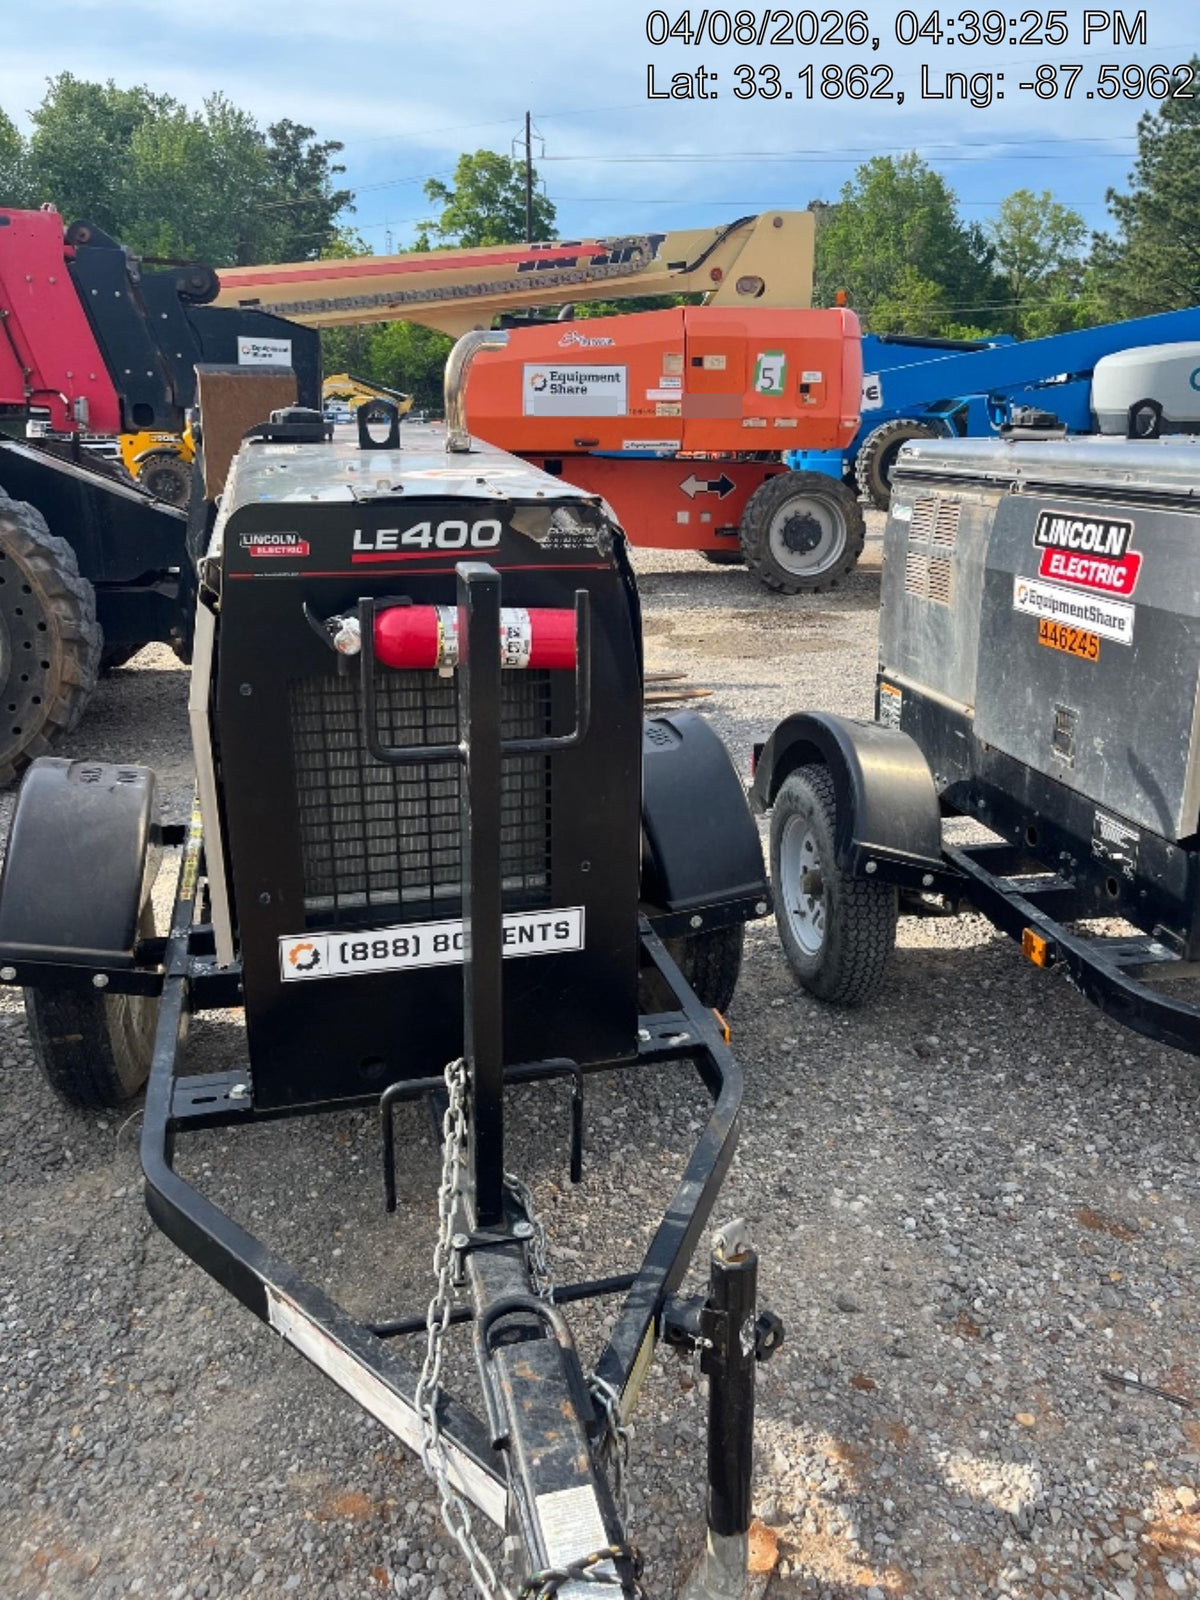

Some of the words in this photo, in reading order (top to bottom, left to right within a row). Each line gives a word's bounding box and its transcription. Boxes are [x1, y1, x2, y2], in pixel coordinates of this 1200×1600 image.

[550, 371, 621, 386] Equipment
[550, 384, 588, 395] Share
[761, 367, 774, 391] 5
[242, 533, 297, 545] LINCOLN
[353, 519, 502, 550] LE400
[1038, 516, 1127, 556] LINCOLN
[256, 546, 304, 554] ELECTRIC
[1049, 553, 1127, 588] ELECTRIC
[1028, 589, 1126, 631] EquipmentShare
[1039, 621, 1099, 658] 446245
[339, 935, 421, 965] (888)
